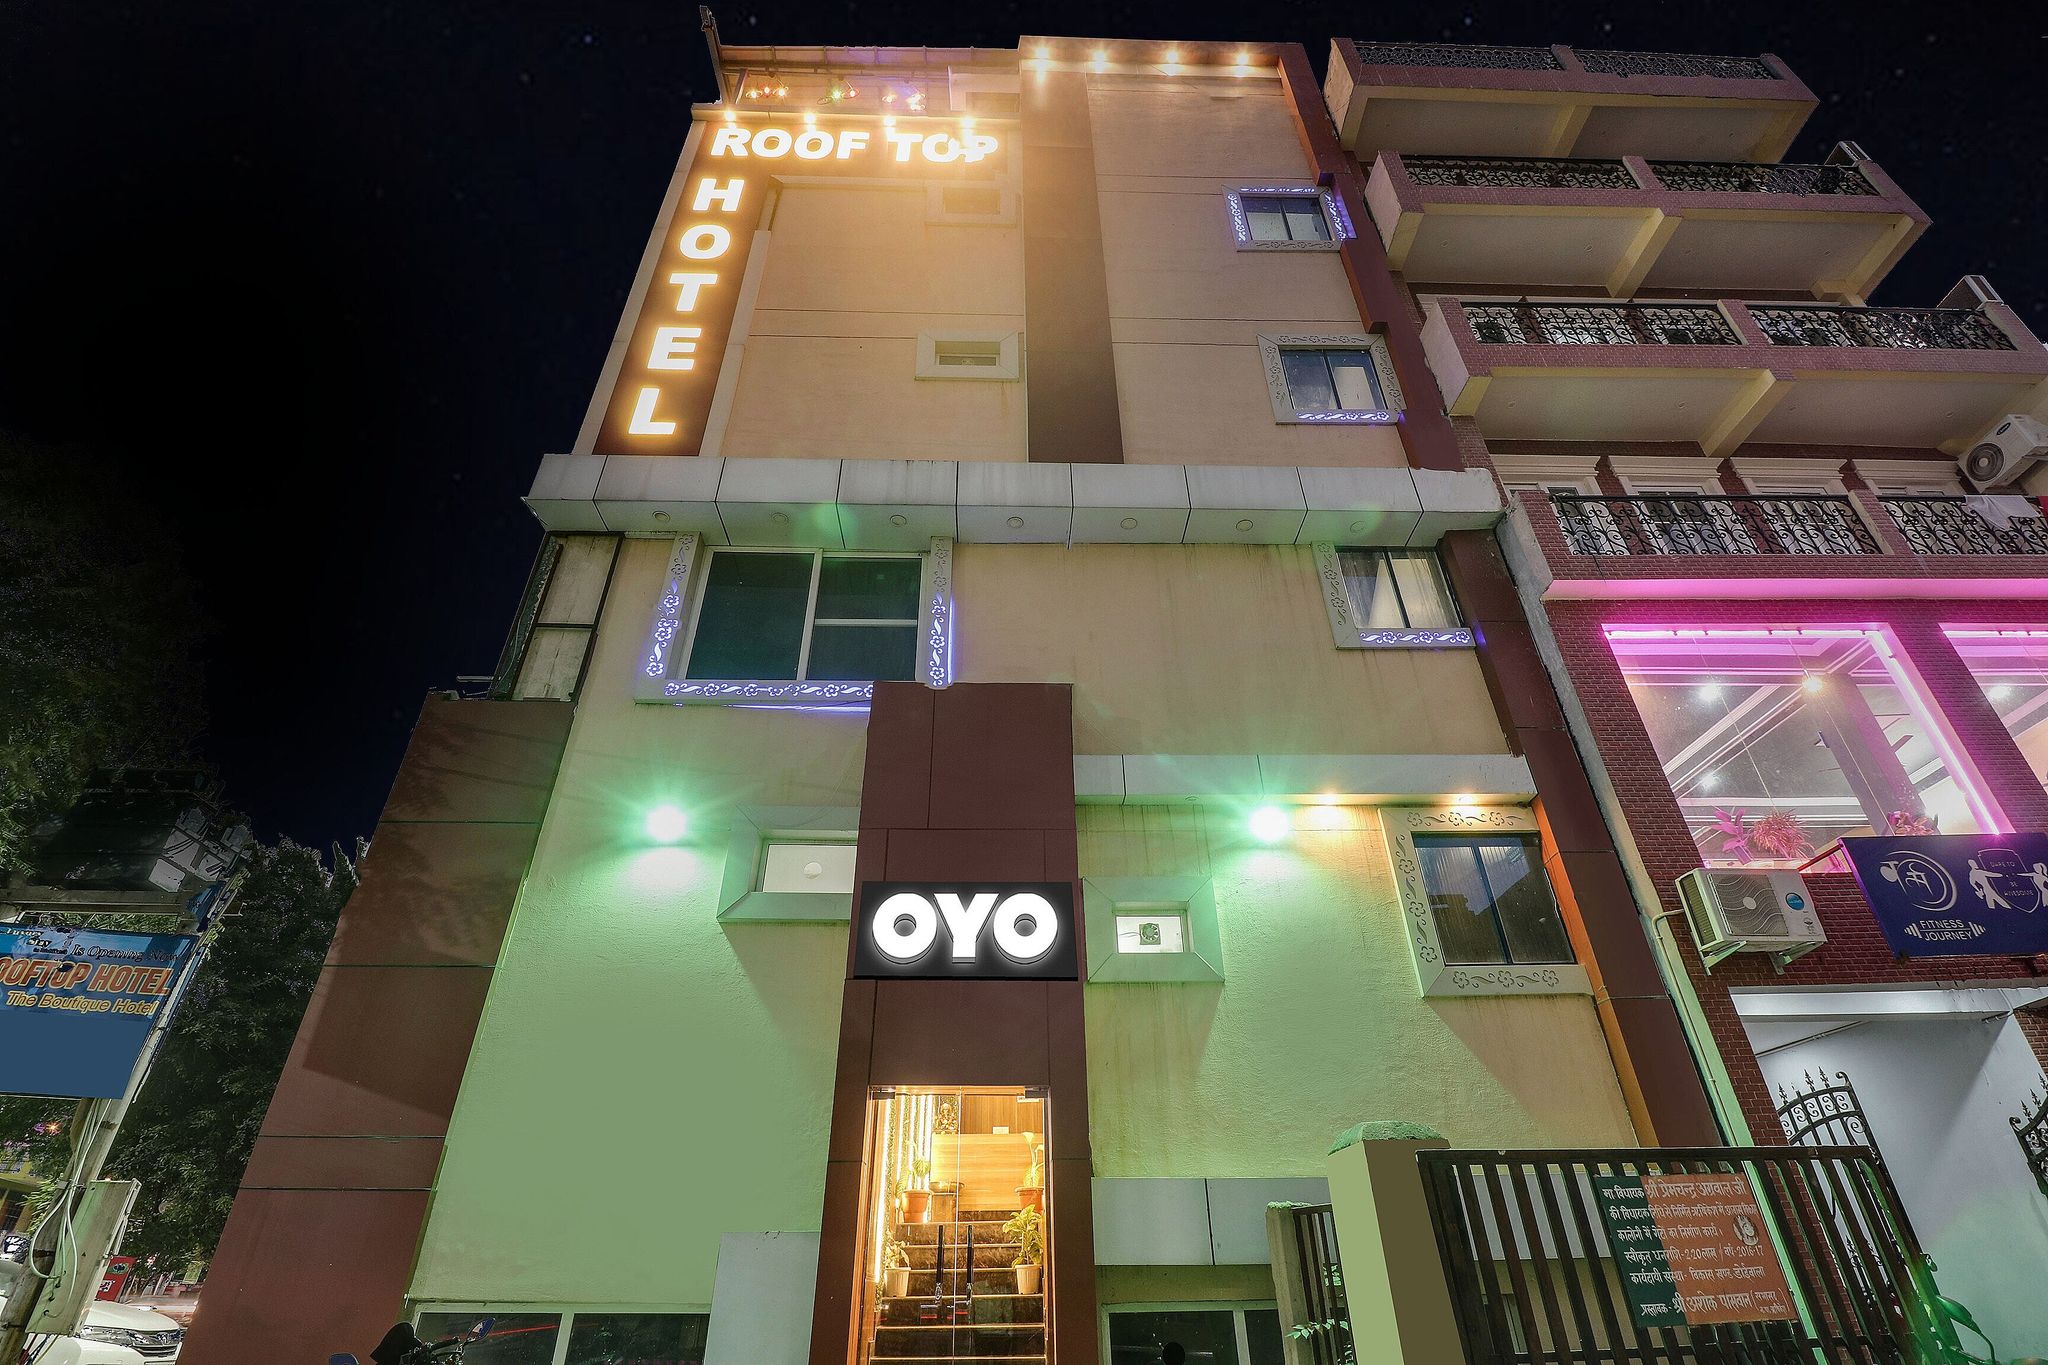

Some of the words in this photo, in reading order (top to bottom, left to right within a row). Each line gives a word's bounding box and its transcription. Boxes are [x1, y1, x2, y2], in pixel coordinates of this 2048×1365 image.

[710, 127, 870, 160] ROOF
[887, 131, 999, 163] TOP
[627, 178, 744, 435] HOTEL
[871, 892, 1058, 964] OYO
[1919, 919, 1965, 930] FITNESS
[1924, 930, 1973, 941] JOURNEY
[87, 945, 143, 962] Opening
[87, 963, 174, 996] HOTEL
[6, 990, 38, 1007] The
[38, 993, 111, 1014] Boutique
[111, 998, 160, 1016] Hotel
[1613, 1185, 1645, 1199] विधायक
[1644, 1179, 1660, 1199] श्री
[1731, 1176, 1747, 1195] जी
[1609, 1205, 1621, 1220] की
[1620, 1205, 1650, 1220] विधायक
[1642, 1225, 1653, 1240] में
[1667, 1227, 1679, 1240] का
[1671, 1291, 1688, 1314] श्री
[1685, 1290, 1718, 1314] अशोक
